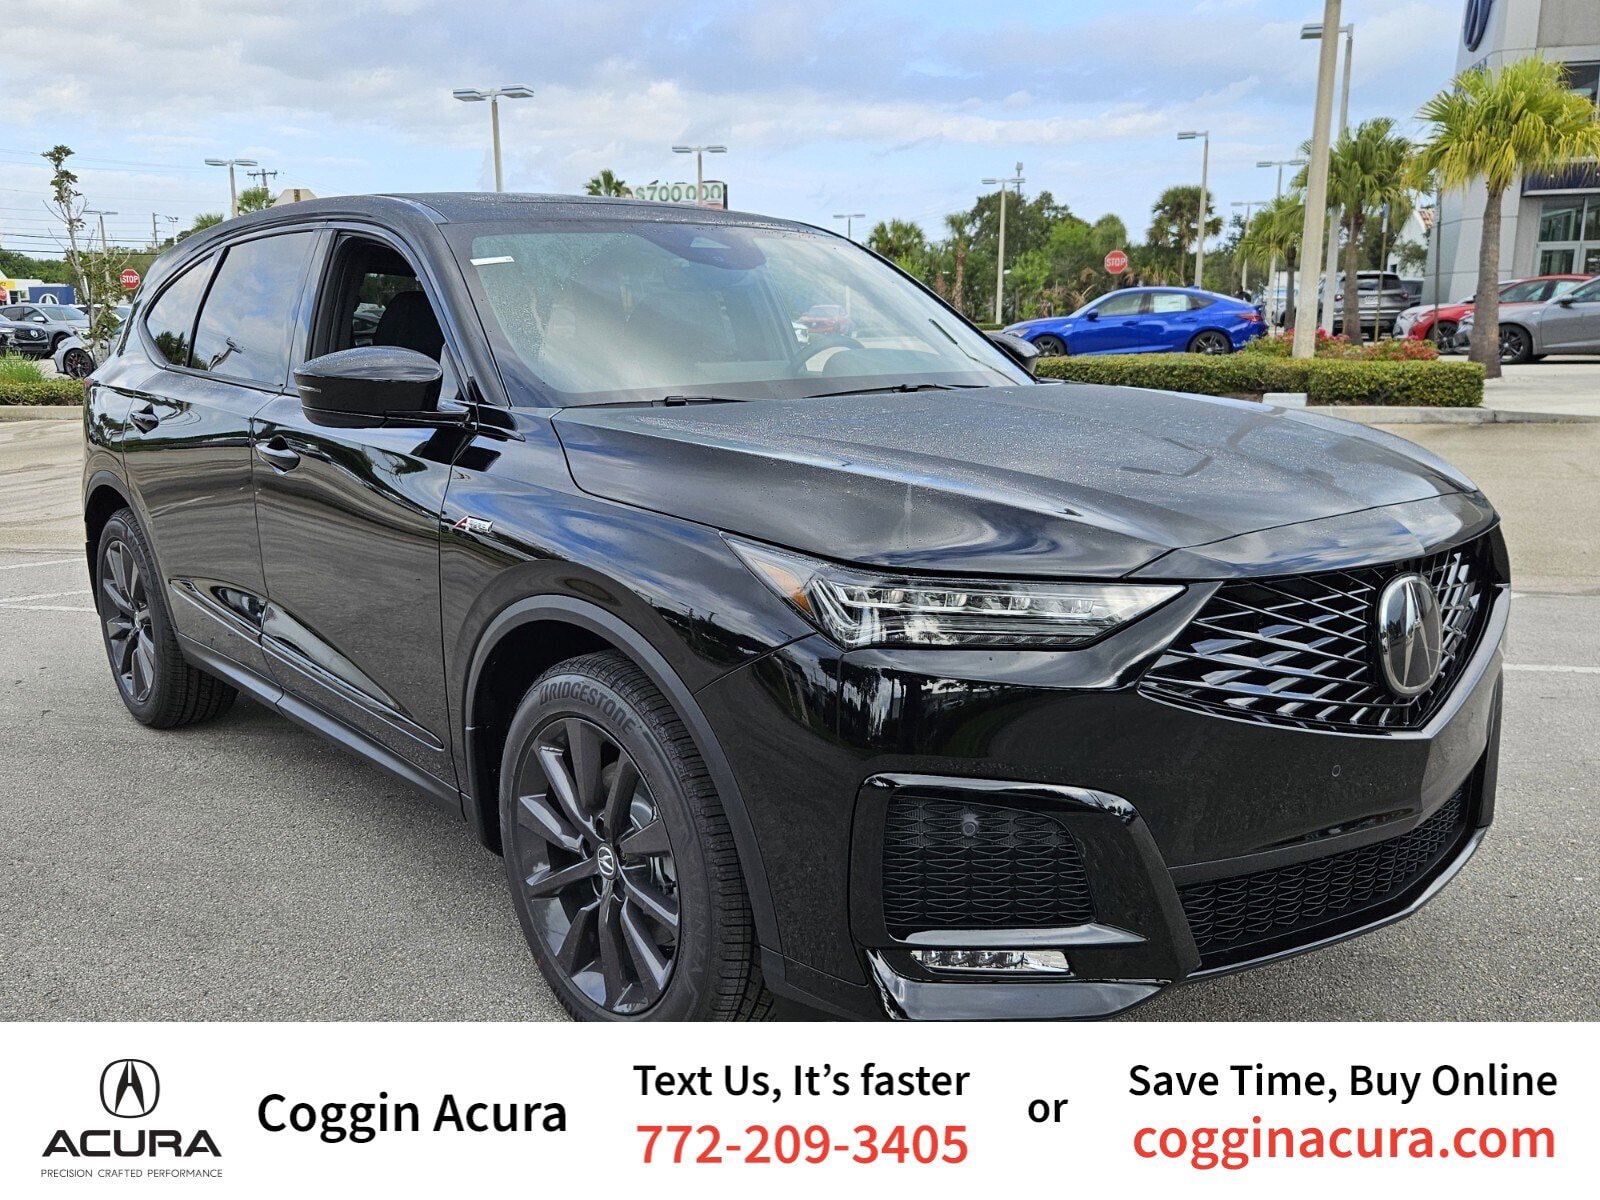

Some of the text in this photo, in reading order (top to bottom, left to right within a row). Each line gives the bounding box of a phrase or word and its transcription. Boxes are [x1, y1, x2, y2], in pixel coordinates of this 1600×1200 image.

[1106, 257, 1126, 267] STOP
[121, 274, 138, 284] STOP
[539, 681, 637, 735] BRIDGESTONE
